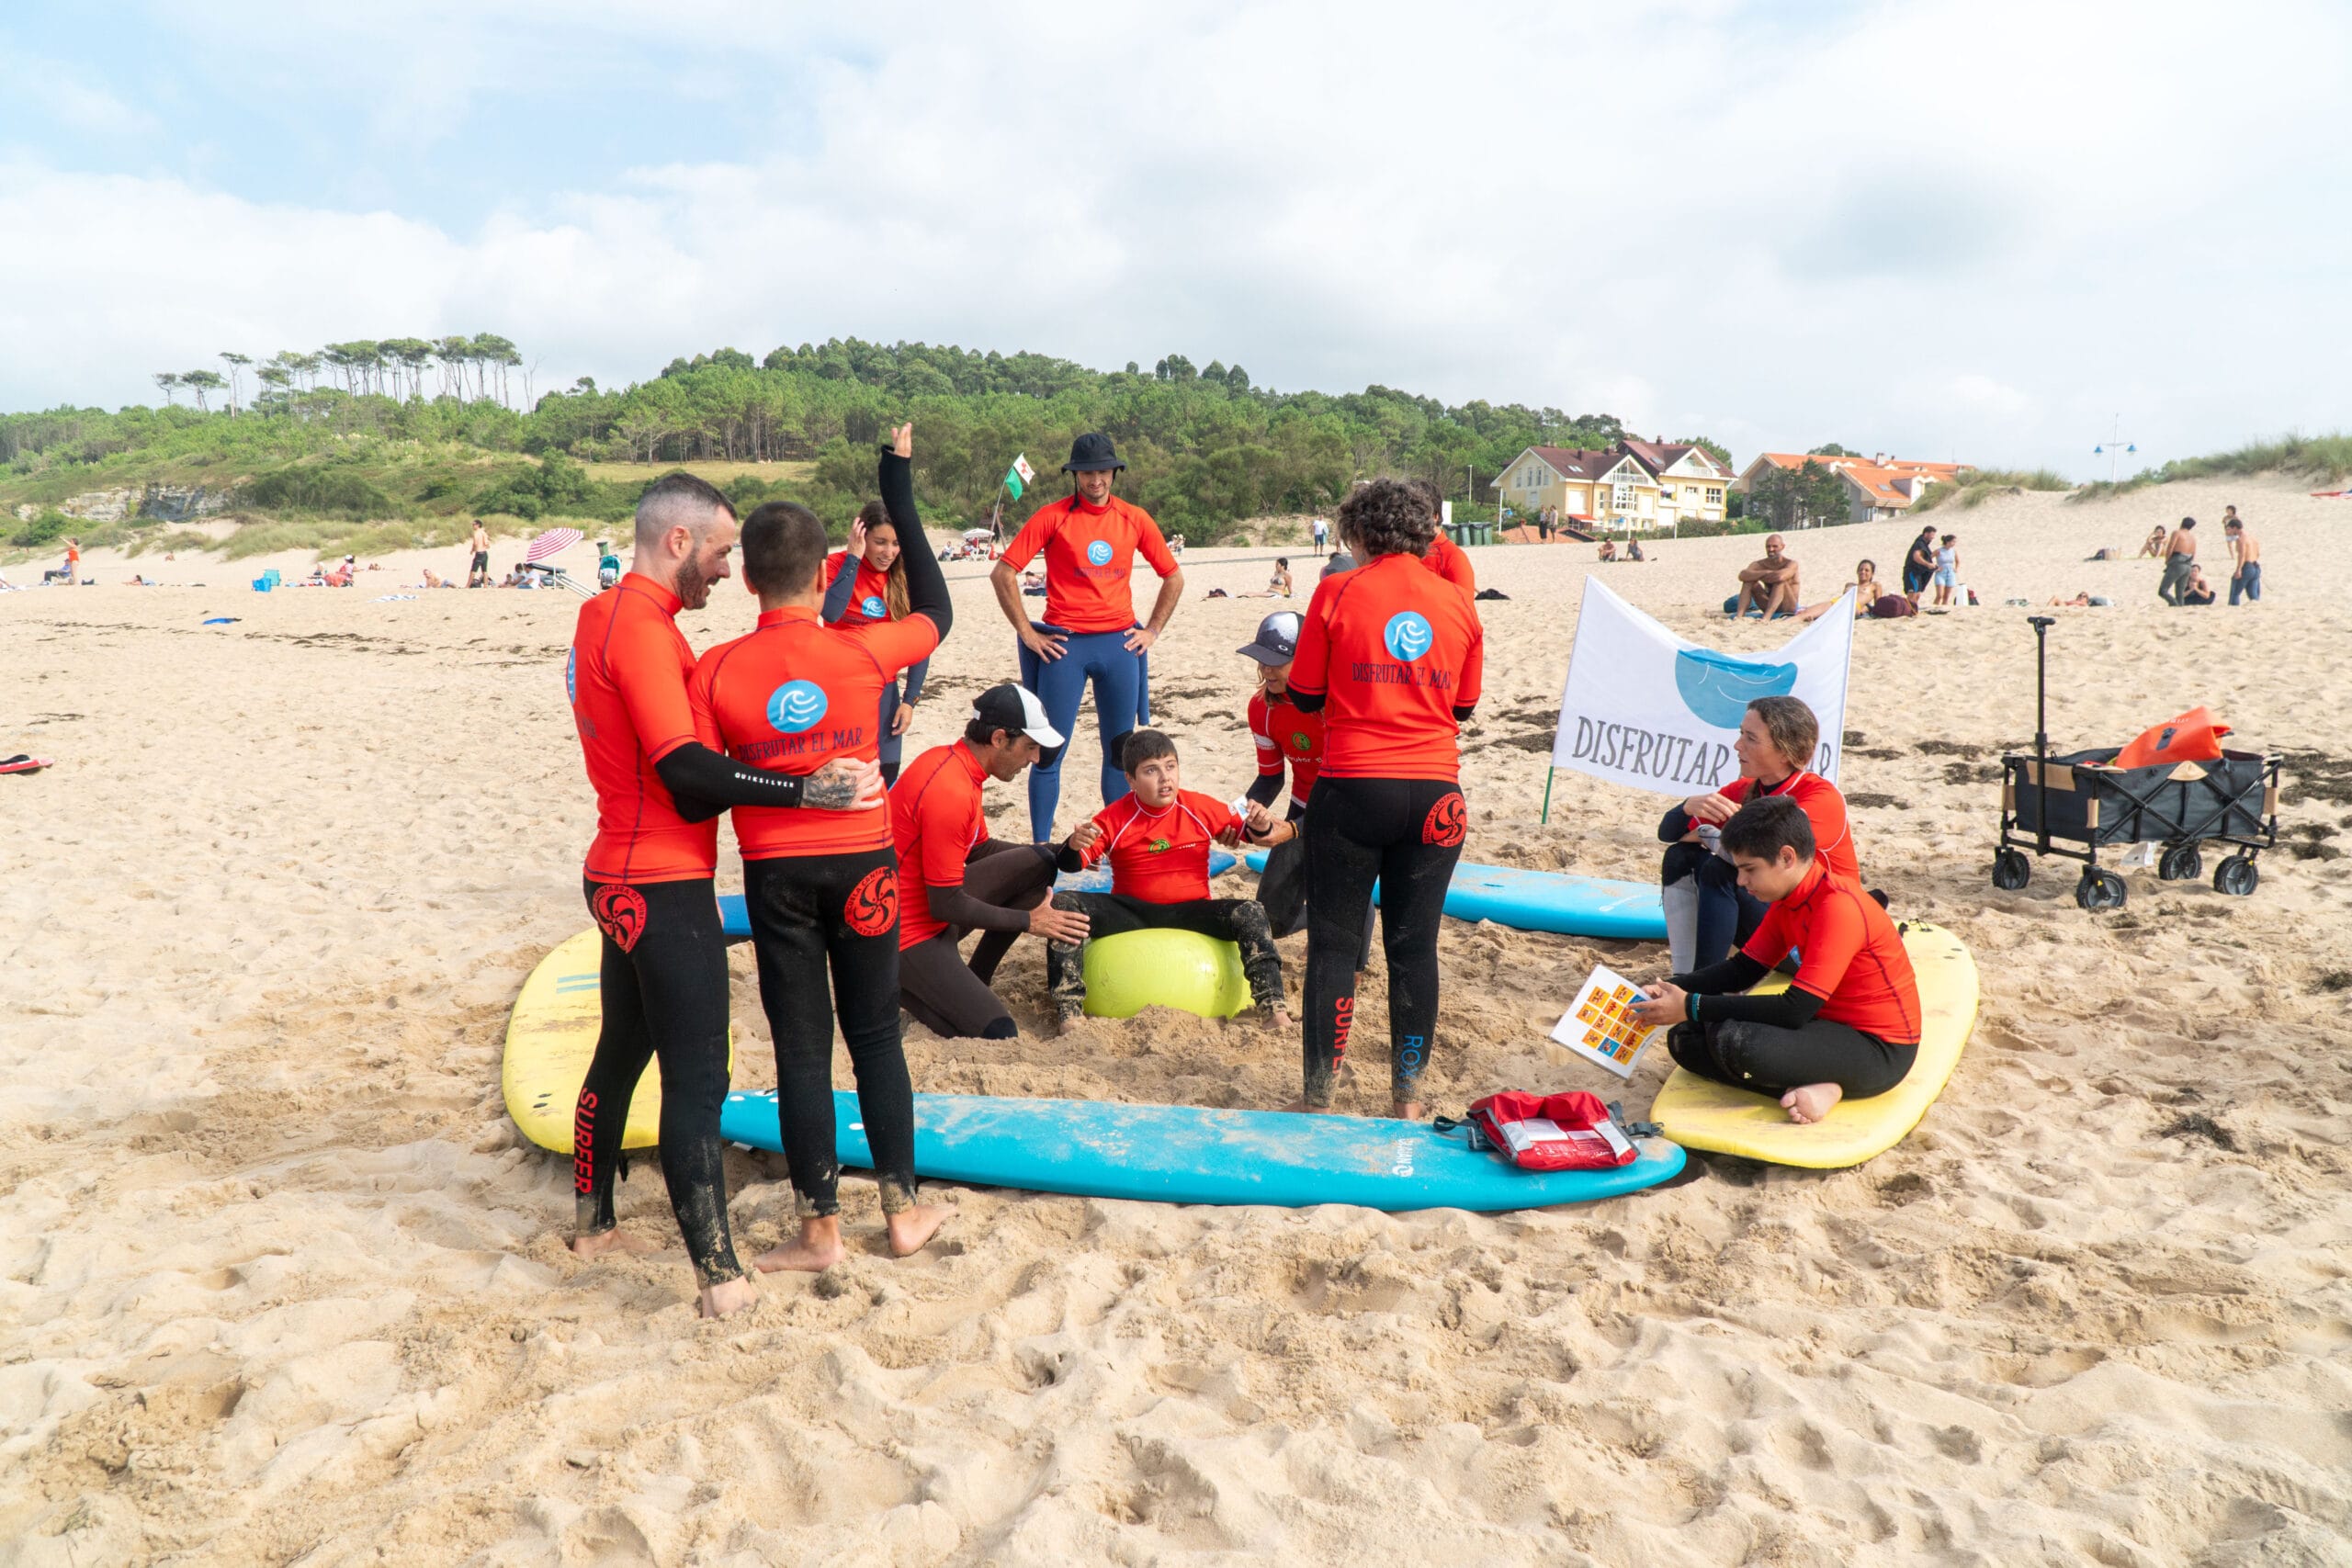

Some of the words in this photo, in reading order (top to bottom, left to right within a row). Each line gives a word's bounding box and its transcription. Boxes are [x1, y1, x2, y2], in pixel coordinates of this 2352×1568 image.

[1351, 662, 1412, 684] DISFRUTAR
[737, 736, 806, 761] DISFRUTAR
[811, 732, 827, 752] EL
[832, 727, 863, 750] MAR
[1572, 716, 1730, 787] DISFRUTAR
[734, 772, 795, 788] QUIKSILVER
[574, 1087, 598, 1194] SURFER
